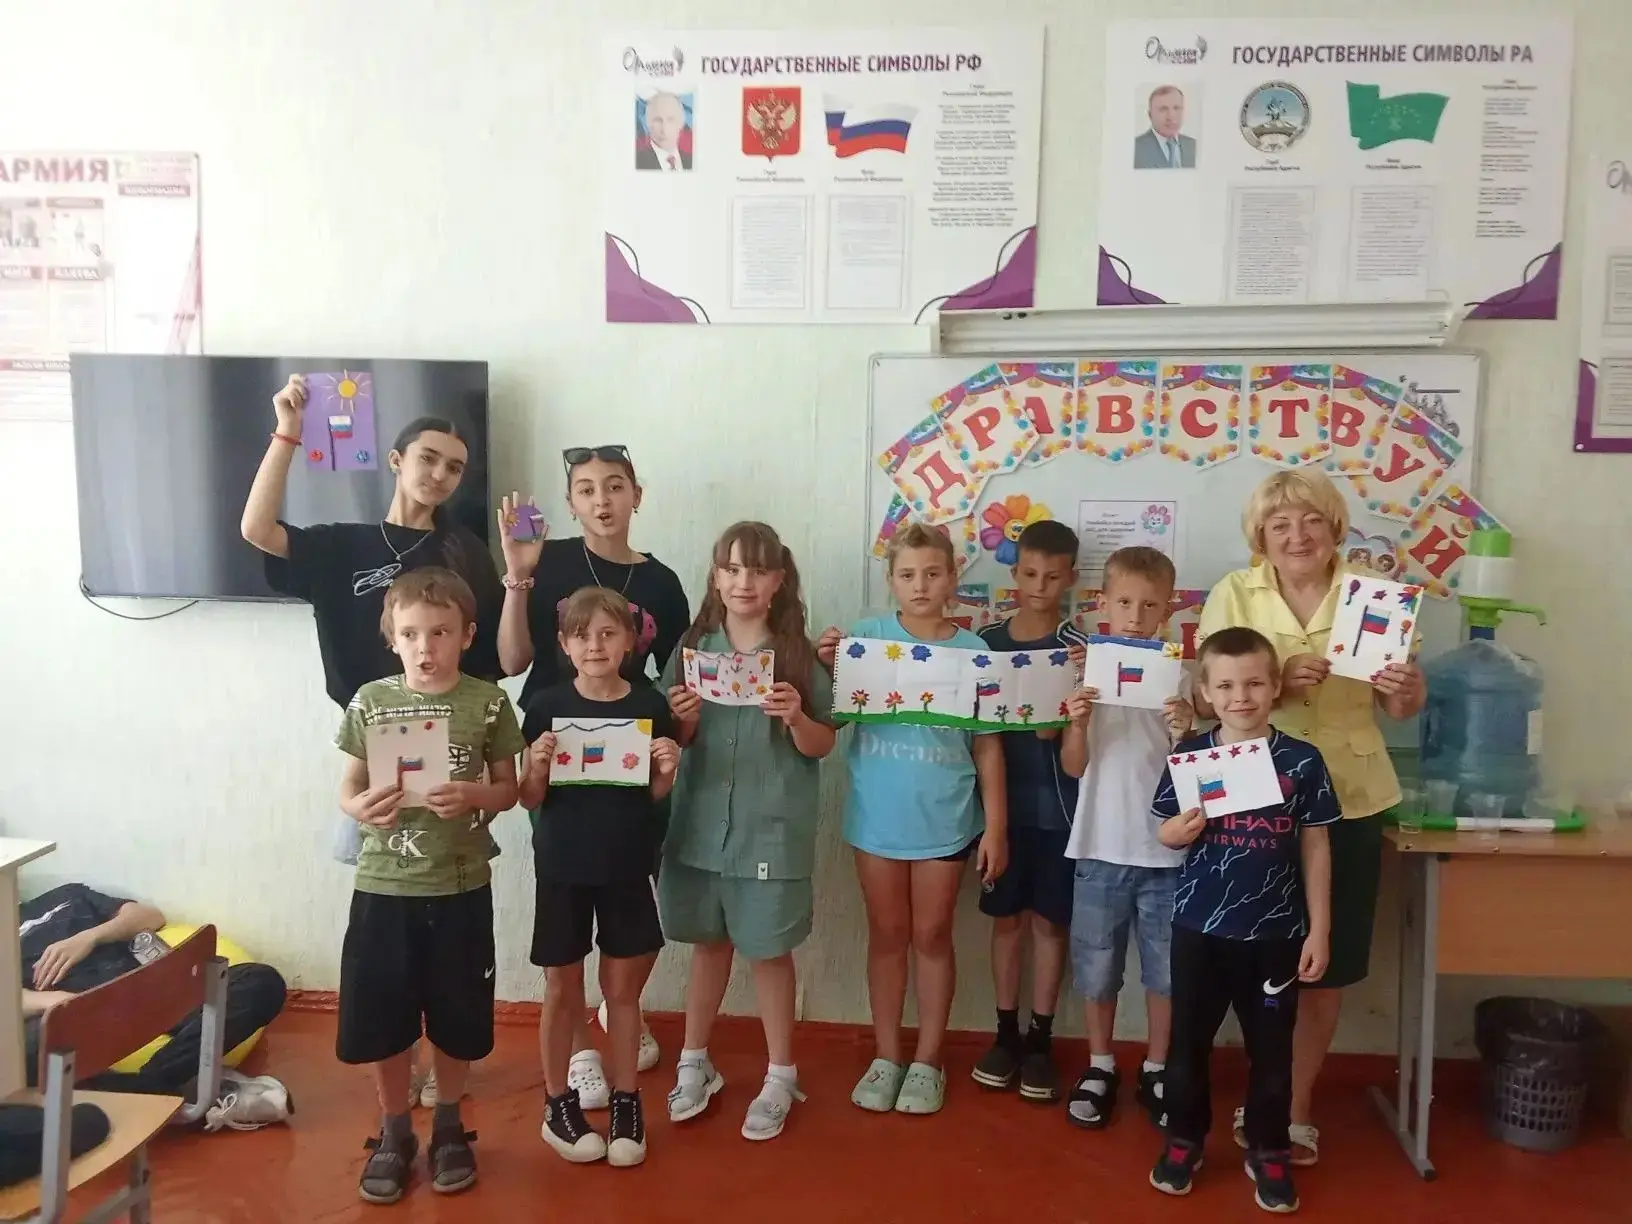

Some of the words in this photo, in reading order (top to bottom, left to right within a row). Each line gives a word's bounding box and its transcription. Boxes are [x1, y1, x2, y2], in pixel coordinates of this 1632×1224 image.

[701, 56, 862, 76] ГОСУДАРСТВЕННЫЕ
[867, 54, 951, 73] СИМВОЛЫ
[956, 53, 983, 71] РФ
[1232, 44, 1407, 67] ГОСУДАРСТВЕННЫЕ
[1412, 44, 1505, 62] СИМВОЛЫ
[1510, 44, 1534, 62] РА
